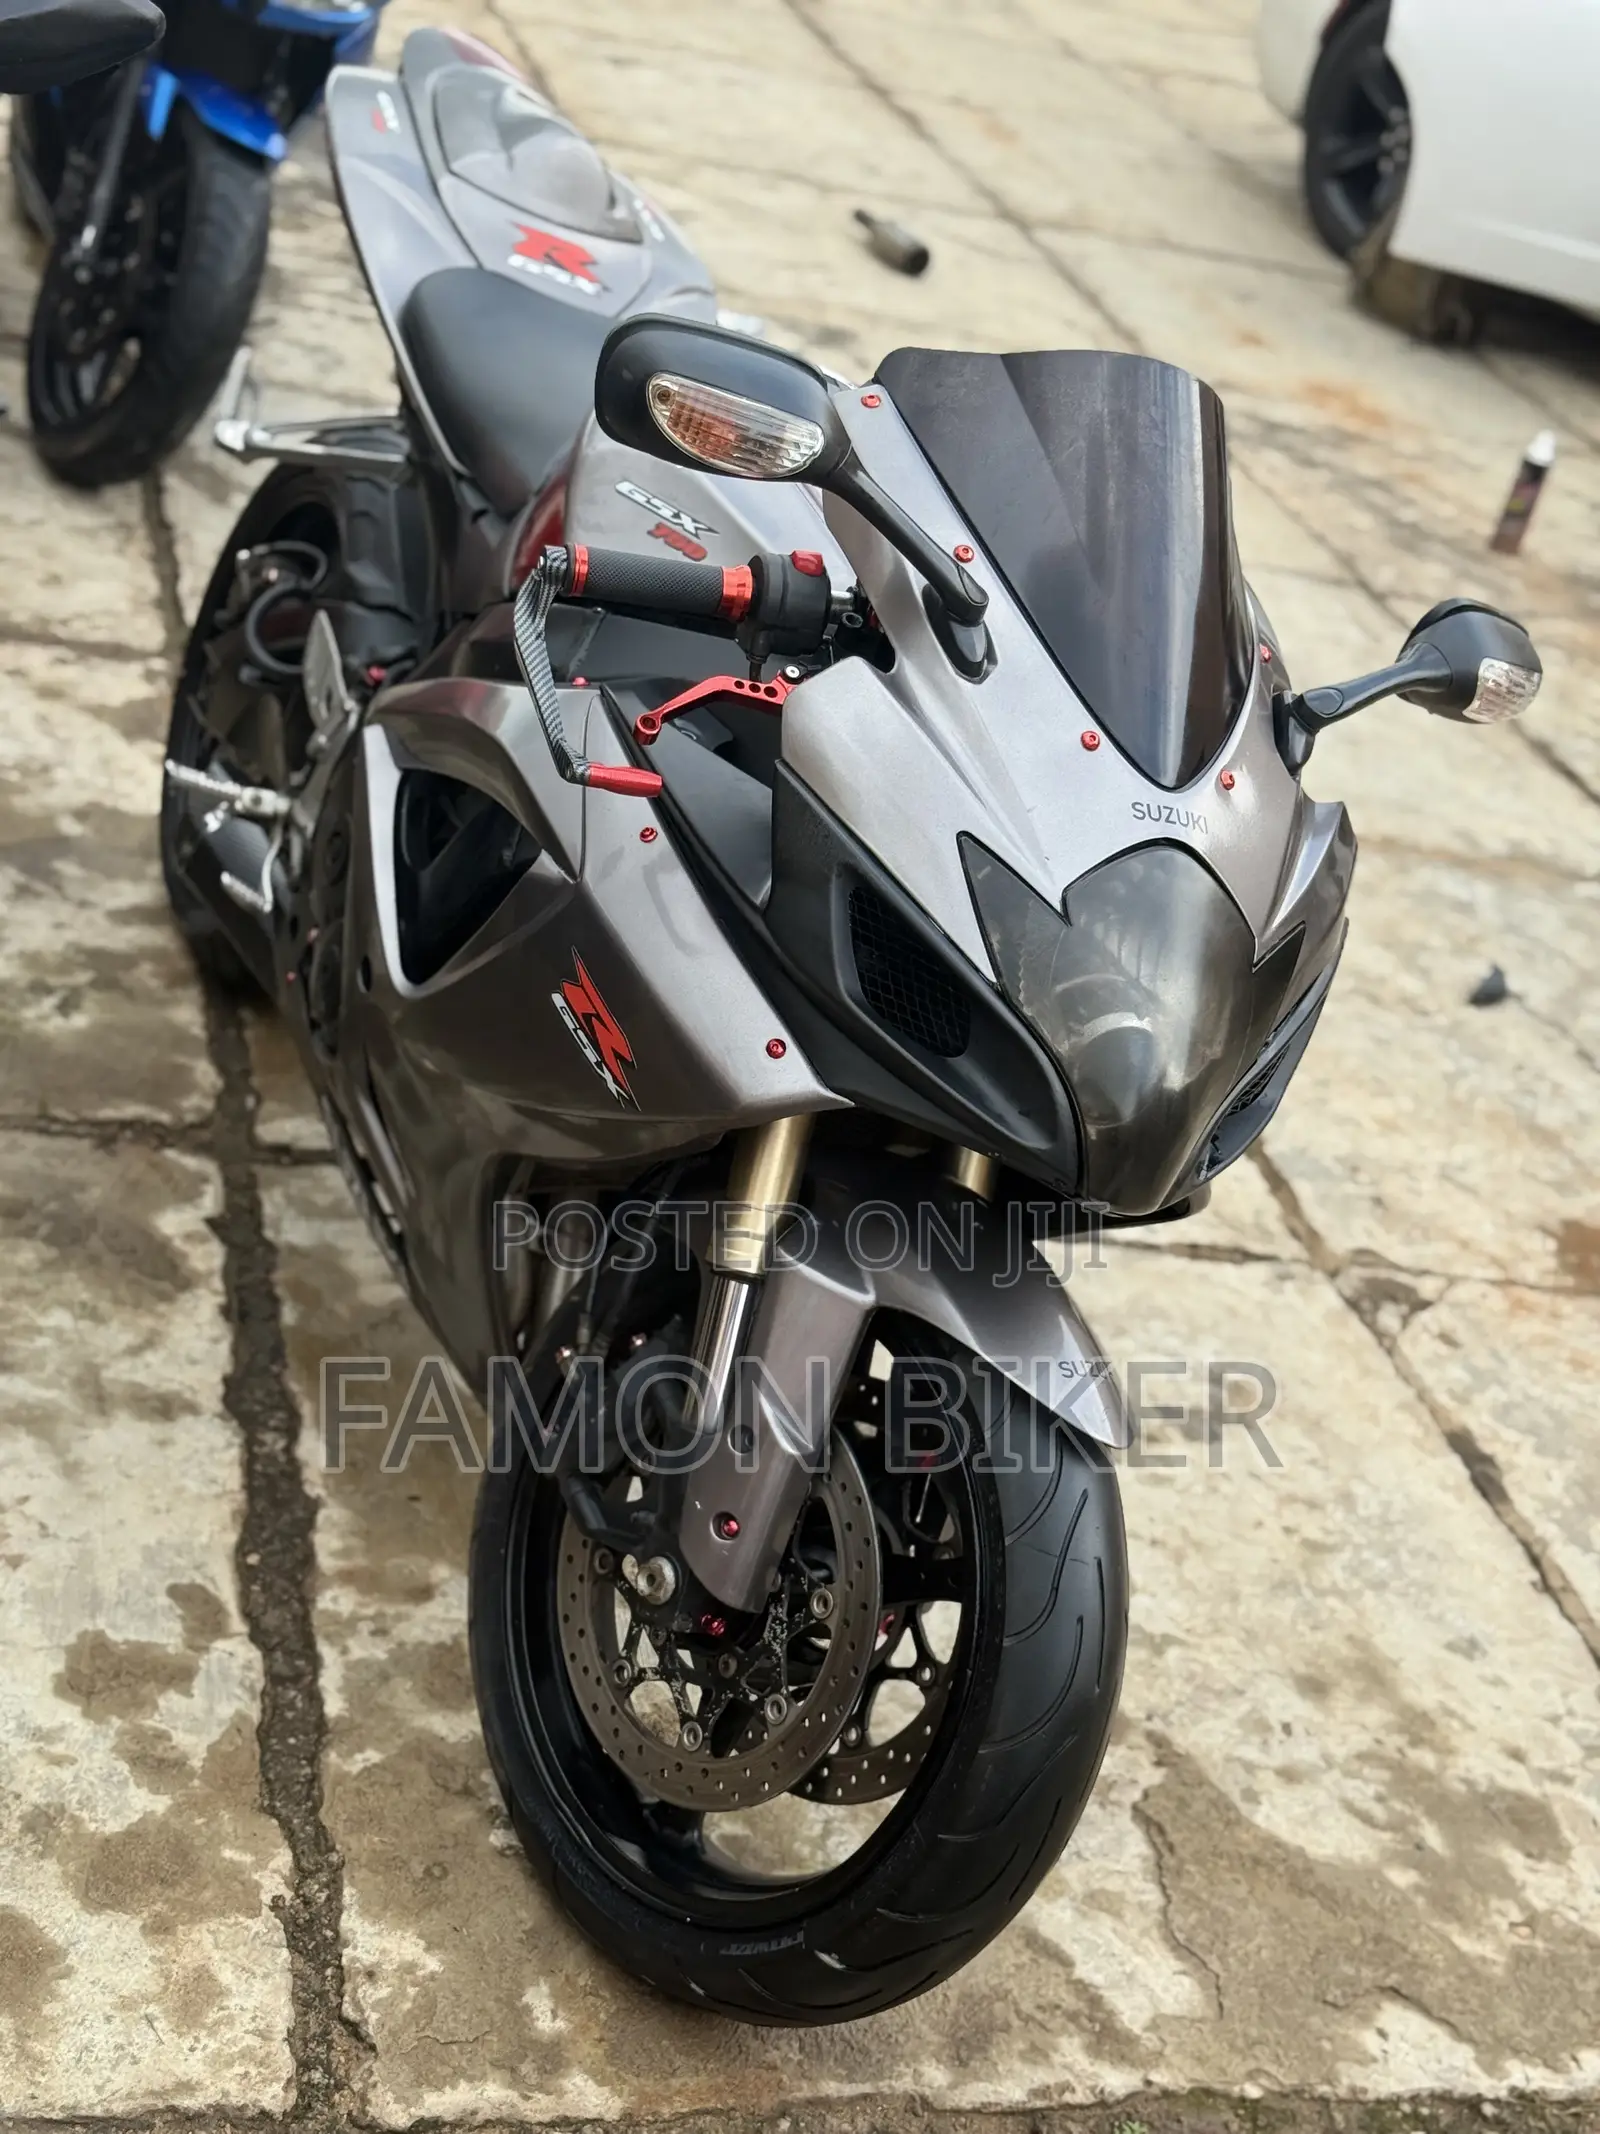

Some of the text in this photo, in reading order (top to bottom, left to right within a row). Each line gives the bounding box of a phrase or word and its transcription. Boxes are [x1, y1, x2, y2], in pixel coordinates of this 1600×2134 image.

[615, 479, 720, 540] GSX
[1131, 801, 1208, 834] SUZUKI
[551, 989, 630, 1109] GSX
